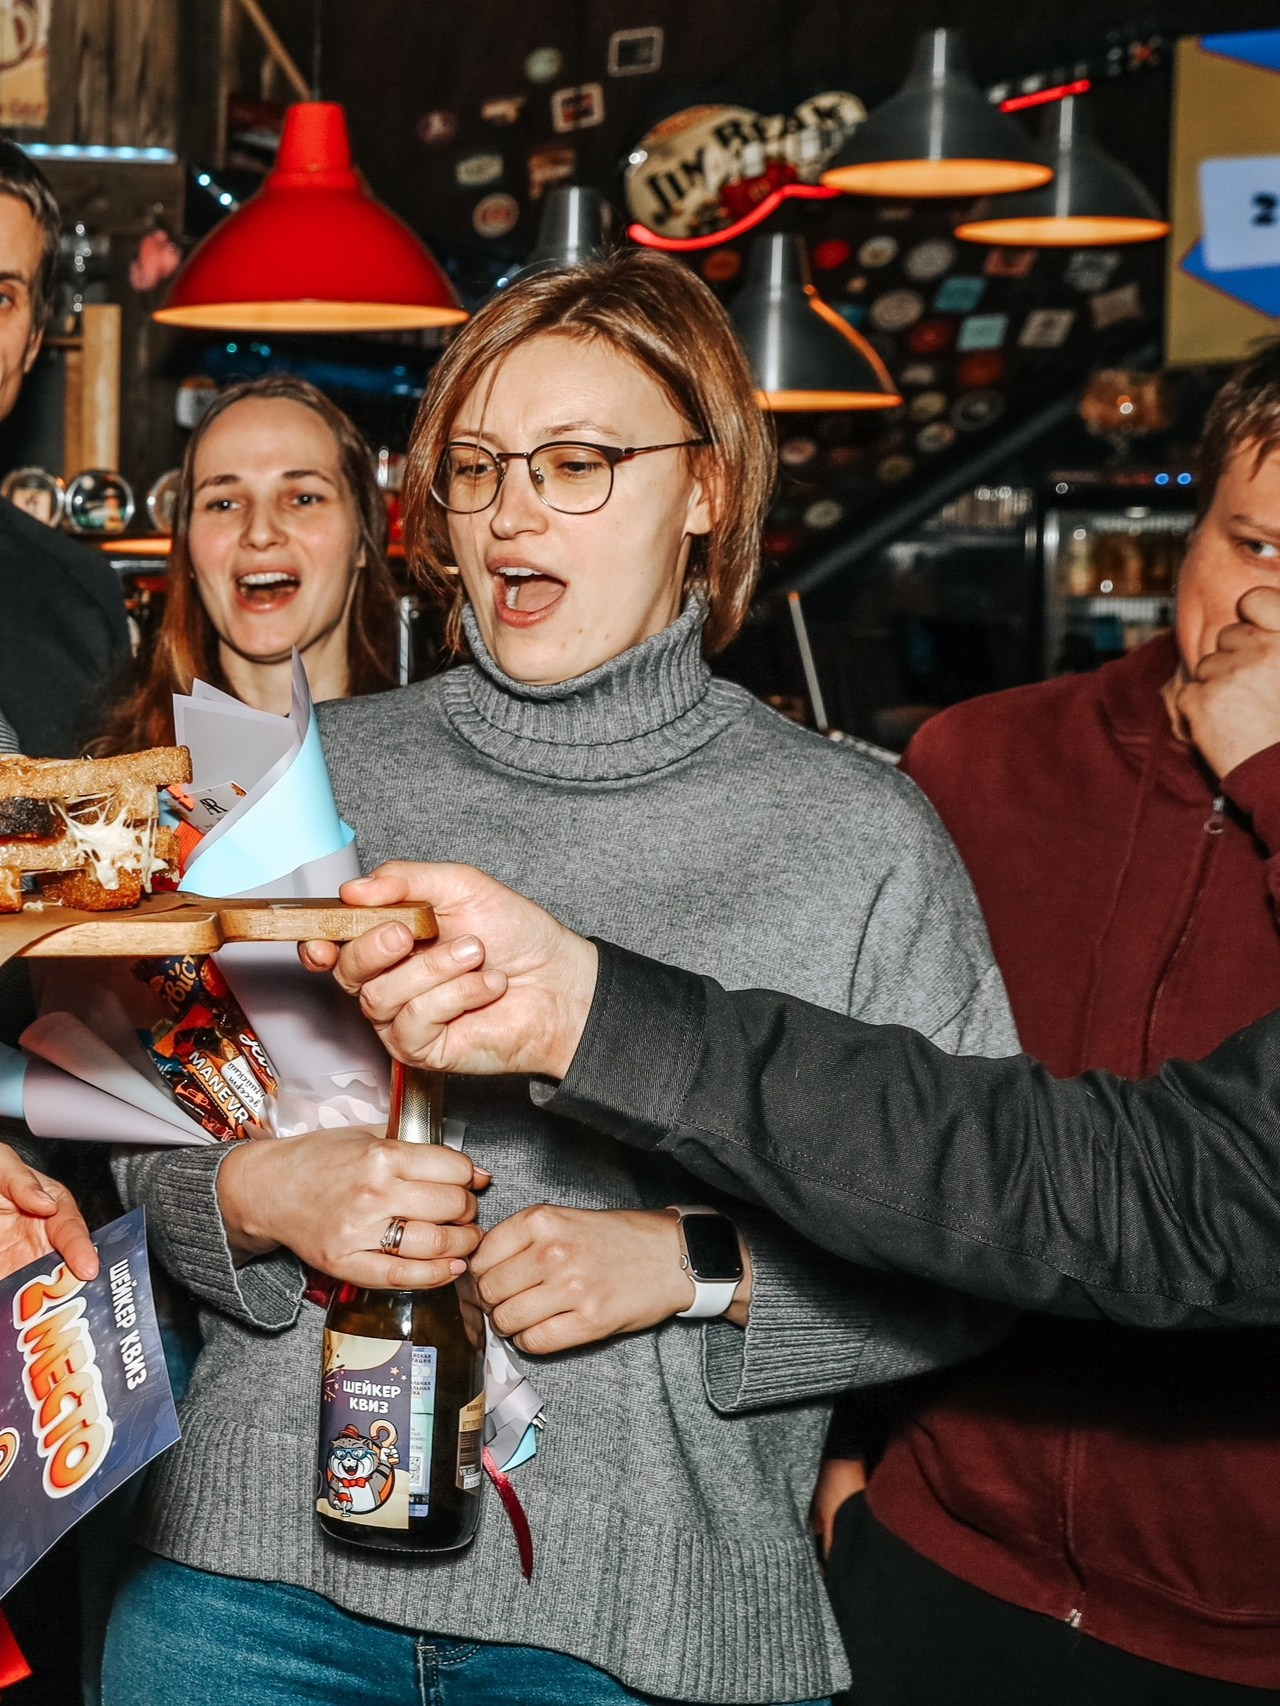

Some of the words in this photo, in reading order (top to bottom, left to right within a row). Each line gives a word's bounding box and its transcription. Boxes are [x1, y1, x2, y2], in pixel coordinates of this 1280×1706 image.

[188, 1051, 250, 1125] MANEVR
[19, 1262, 83, 1323] 2
[109, 1258, 138, 1329] ШЕЙКЕР
[120, 1329, 148, 1391] КВИЗ
[342, 1379, 402, 1400] ШЕЙКЕР
[22, 1302, 112, 1491] МЕСТО
[349, 1397, 390, 1414] КВИЗ
